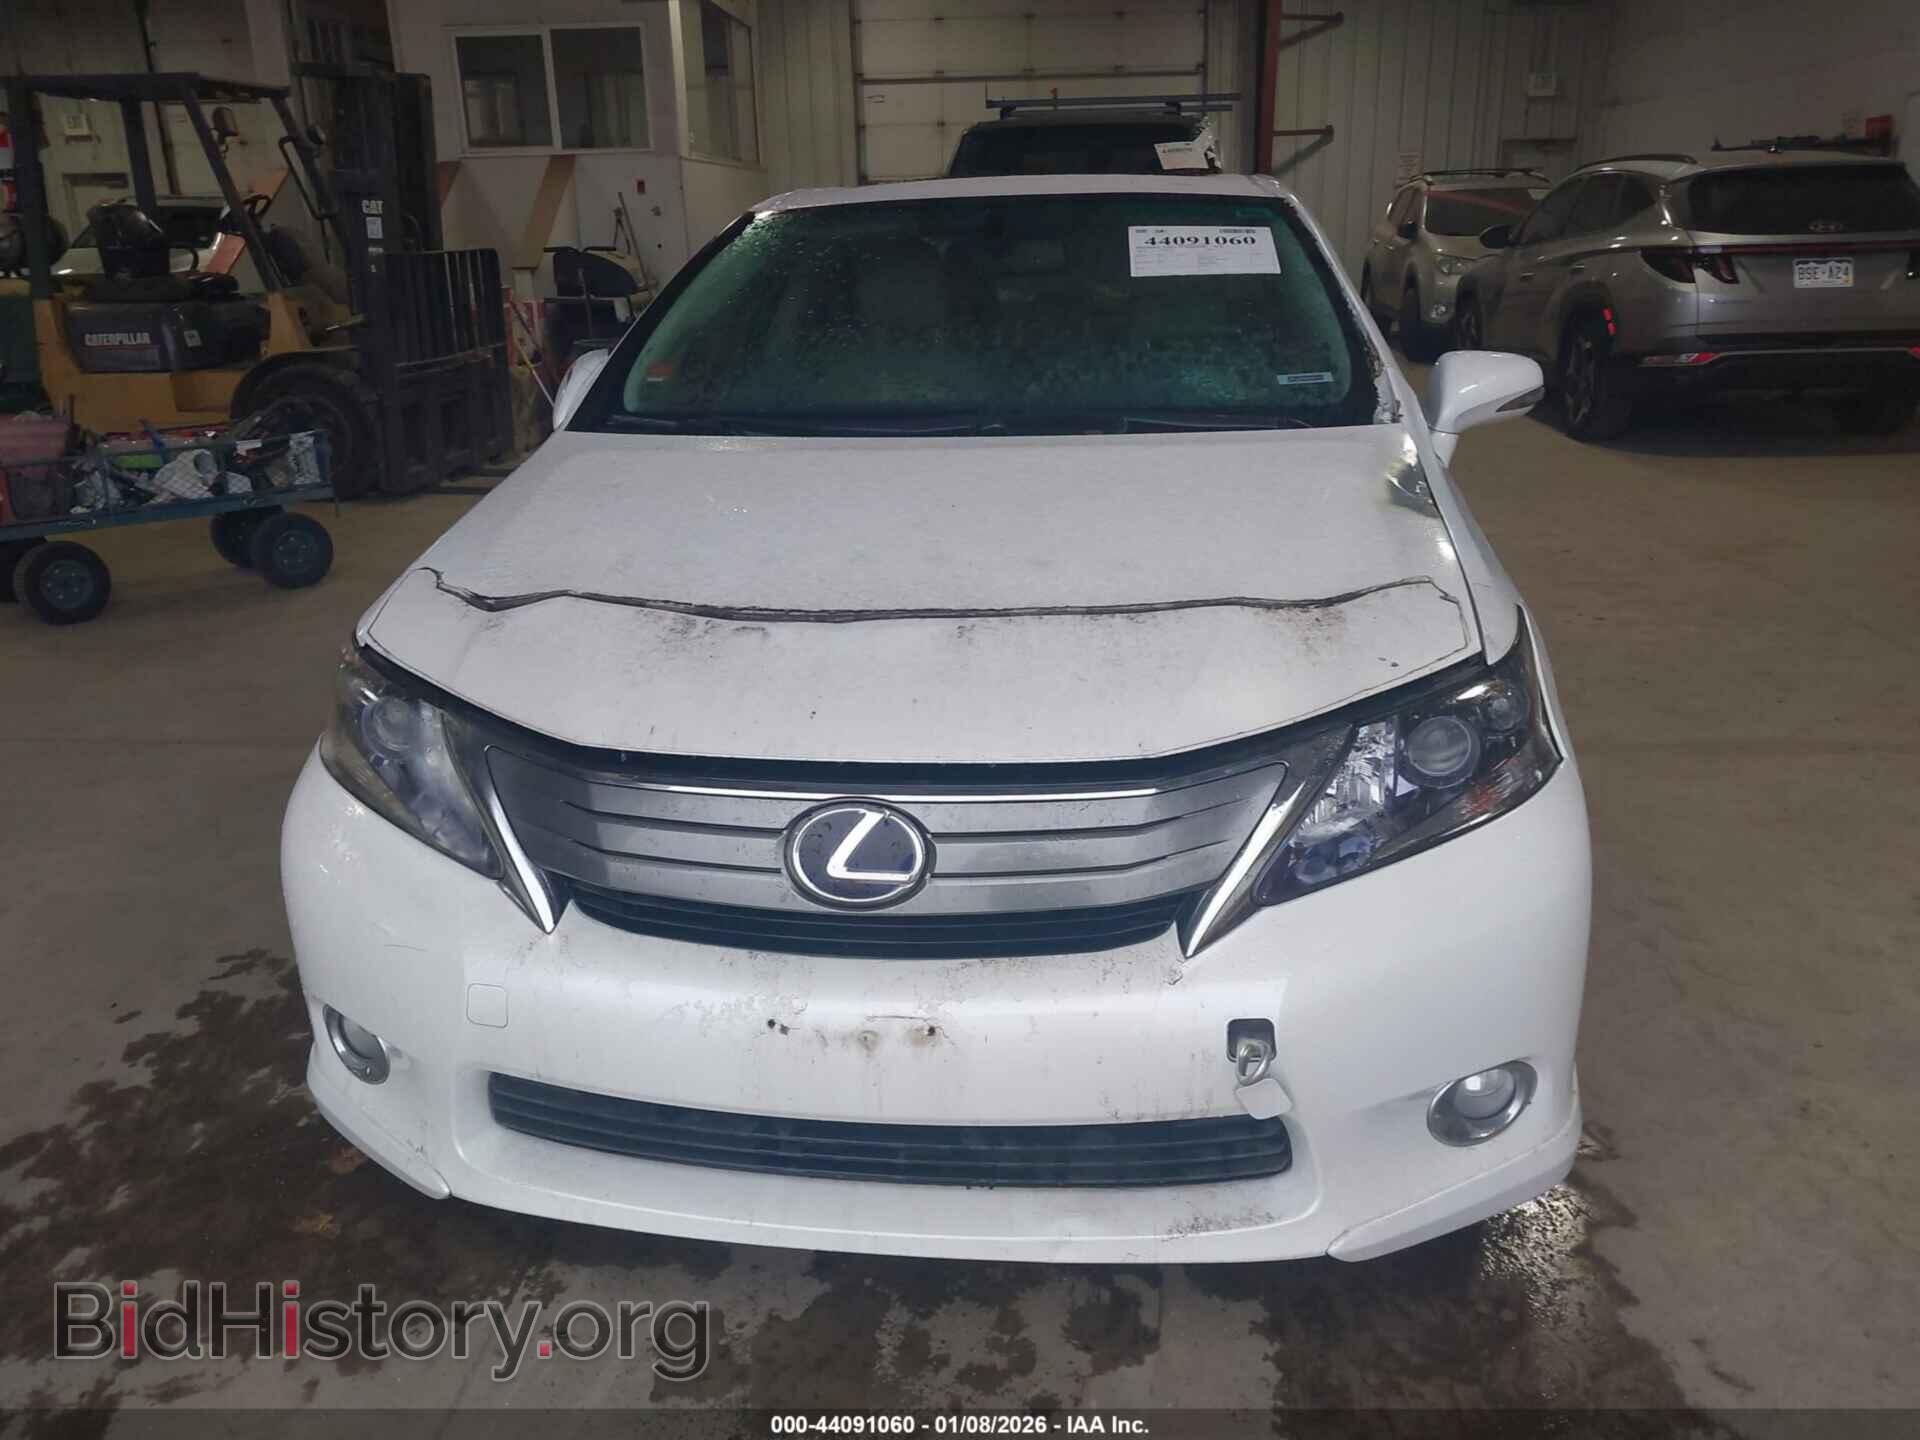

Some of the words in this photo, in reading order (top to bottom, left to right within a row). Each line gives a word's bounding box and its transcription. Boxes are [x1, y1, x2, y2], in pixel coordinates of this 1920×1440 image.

[361, 199, 385, 215] CAT
[1144, 235, 1257, 247] 44091060
[84, 331, 151, 346] CATERPILLAR
